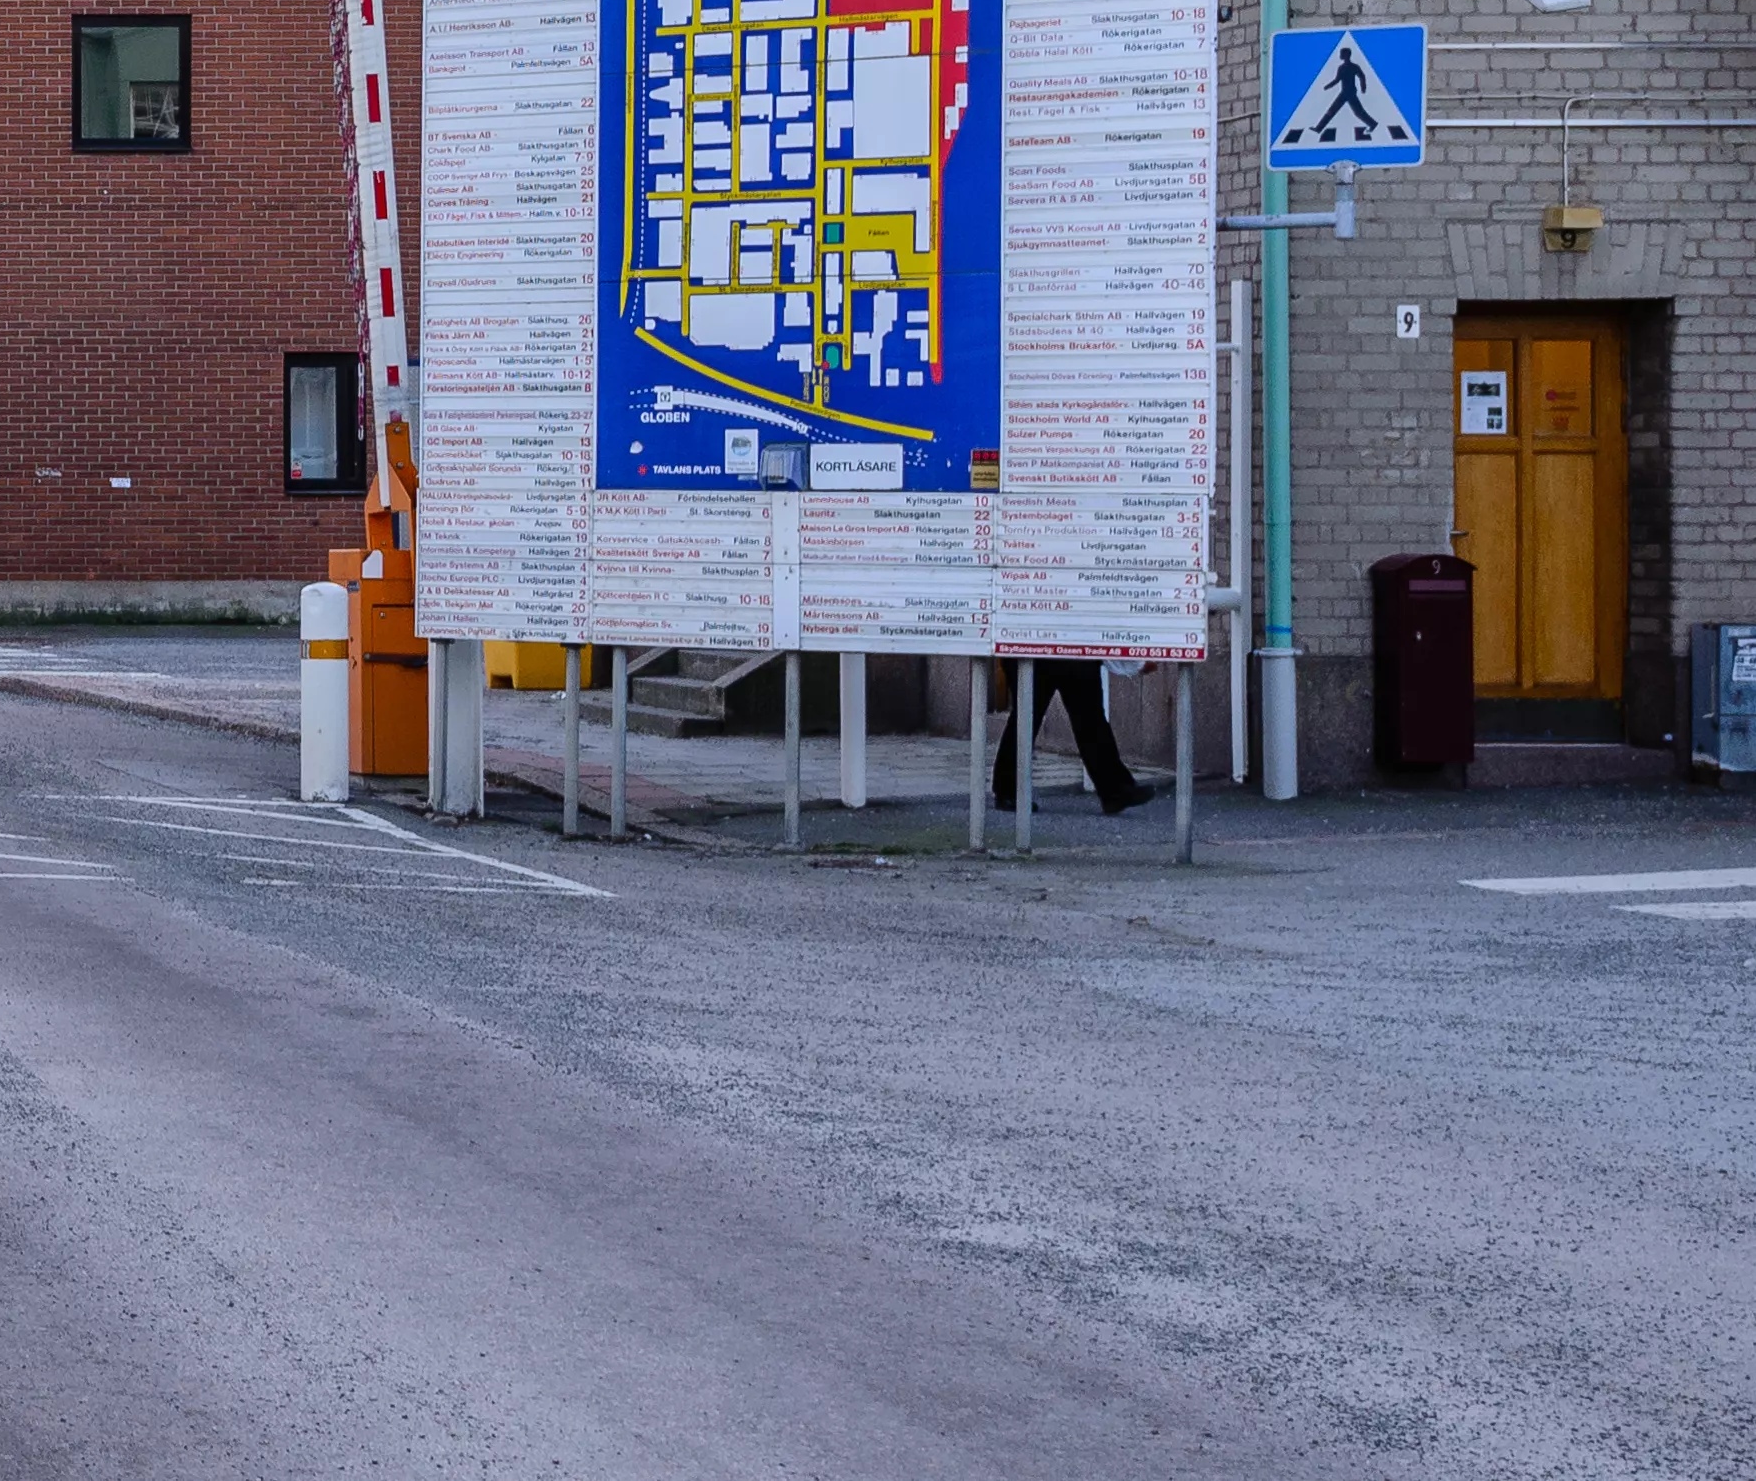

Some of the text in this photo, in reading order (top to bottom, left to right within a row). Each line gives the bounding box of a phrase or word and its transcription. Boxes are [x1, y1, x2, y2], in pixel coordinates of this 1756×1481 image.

[1132, 85, 1189, 96] Rökerigatan
[1197, 83, 1205, 94] 4
[1057, 137, 1071, 145] AB
[1105, 132, 1162, 143] Rökerigatan
[1192, 128, 1205, 139] 19
[1199, 159, 1206, 169] 4
[582, 193, 593, 203] 21
[1560, 230, 1577, 248] 9
[1192, 309, 1205, 319] 19
[1404, 312, 1415, 333] 9
[503, 384, 514, 392] AB
[523, 384, 581, 393] Slakthusgatan
[641, 412, 690, 423] GLOBEN
[1008, 414, 1060, 424] Stockholm
[1096, 415, 1109, 423] AB
[1199, 414, 1206, 424] 8
[1189, 429, 1205, 439] 20
[512, 437, 553, 446] Hallvägen
[580, 437, 591, 447] 13
[653, 465, 721, 474] TAVLANS PLATS
[816, 461, 896, 472] KORTLÄSARE
[1102, 474, 1117, 483] AB
[1192, 474, 1205, 484] 10
[1193, 498, 1201, 508] 4
[874, 510, 940, 520] Slakthusgatan
[975, 511, 990, 521] 22
[1177, 512, 1199, 523] 3-5
[975, 525, 990, 536] 20
[688, 549, 700, 558] AB
[763, 551, 769, 560] 7
[580, 563, 586, 572] 4
[764, 567, 771, 577] 3
[1432, 560, 1441, 575] 9
[1185, 574, 1199, 584] 21
[880, 626, 963, 637] Styckmästargatan
[980, 628, 986, 637] 7
